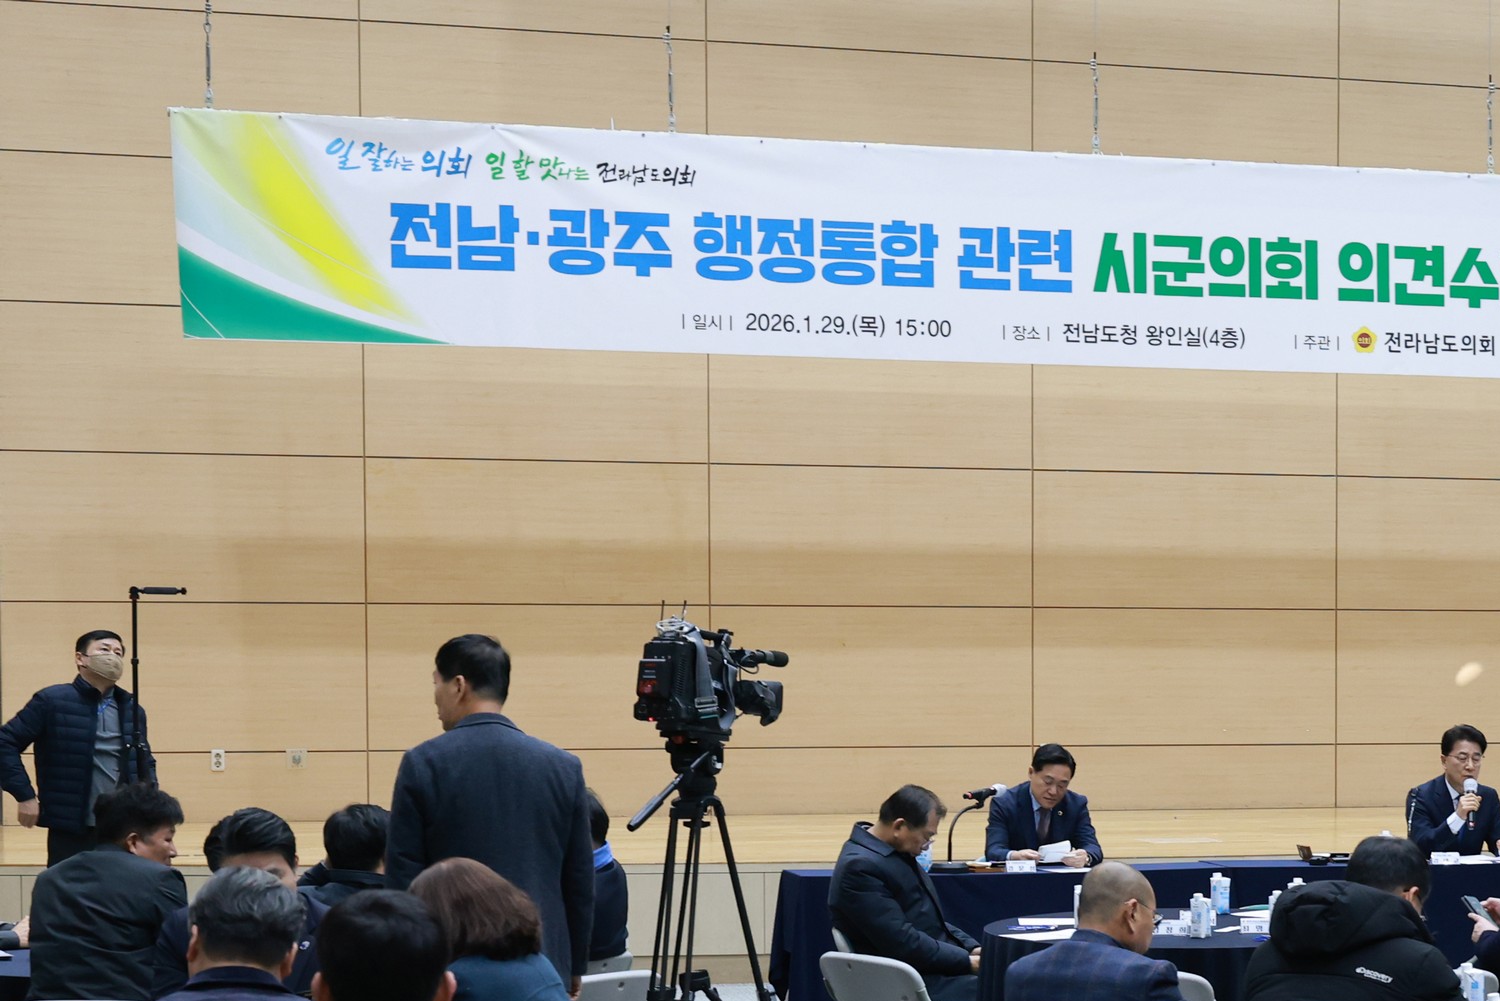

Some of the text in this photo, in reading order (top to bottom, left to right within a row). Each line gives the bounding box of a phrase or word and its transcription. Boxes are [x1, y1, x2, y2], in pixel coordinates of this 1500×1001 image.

[421, 146, 473, 179] 의회
[596, 161, 697, 187] 전라남도의회
[389, 202, 673, 278] 전남·광주
[693, 211, 939, 288] 행정통합
[957, 225, 1074, 293] 관련
[1093, 232, 1318, 300] 시군의회
[692, 313, 1331, 350] 일시 2026.1.29.(목) 15:00 장소 전남도청 왕인실(4층) 주관
[1384, 331, 1496, 356] 전라남도의회
